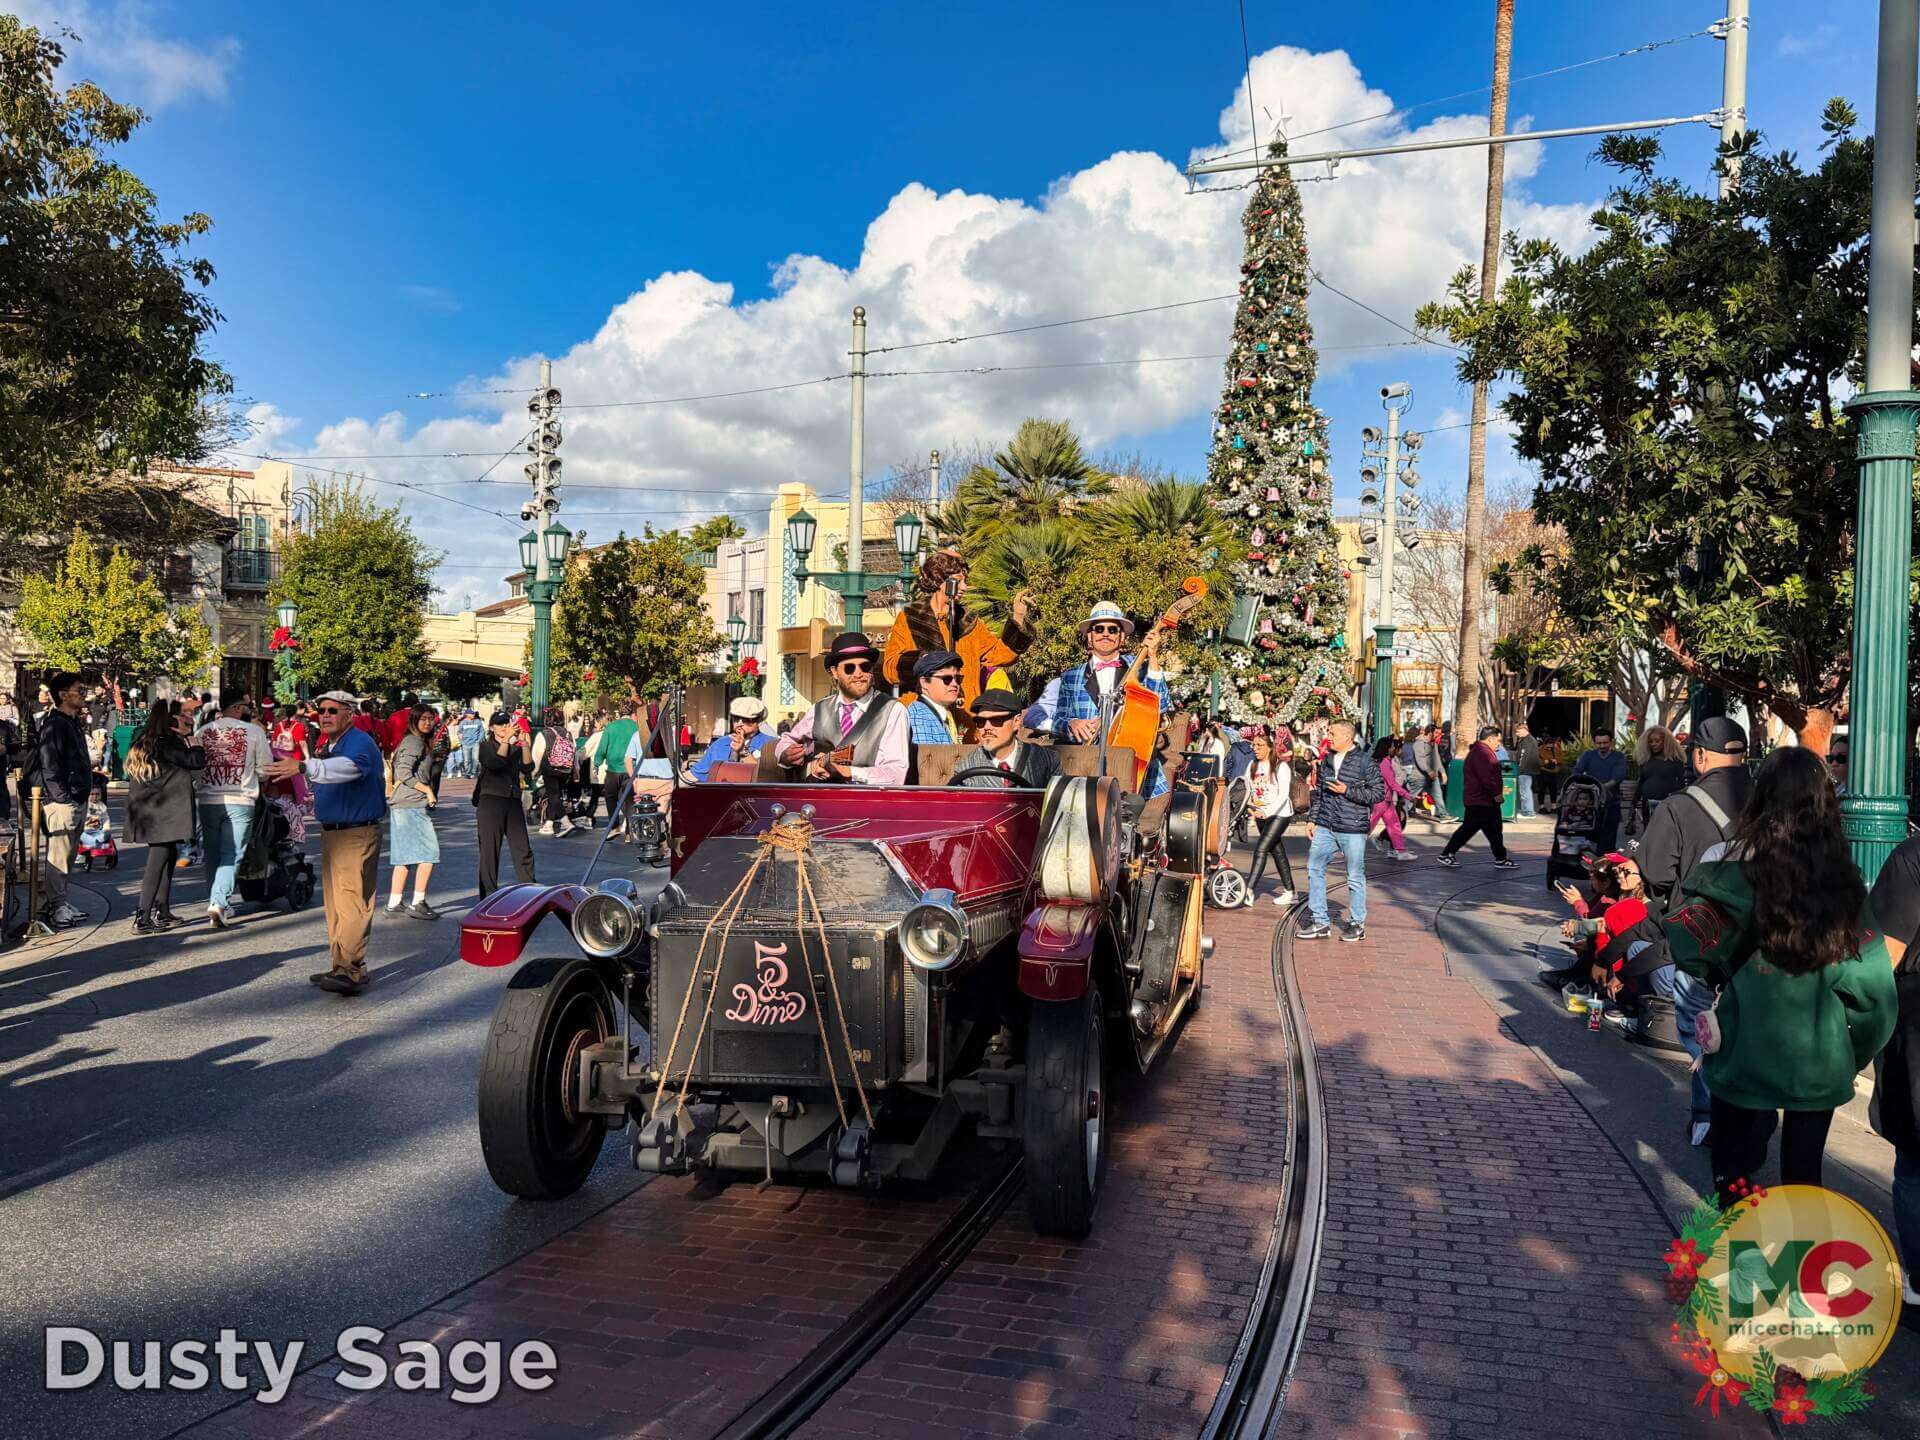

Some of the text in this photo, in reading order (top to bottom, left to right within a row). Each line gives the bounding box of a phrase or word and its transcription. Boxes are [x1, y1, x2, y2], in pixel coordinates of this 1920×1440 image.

[754, 940, 788, 988] 5
[756, 967, 786, 1003] &
[725, 983, 806, 1025] Dime
